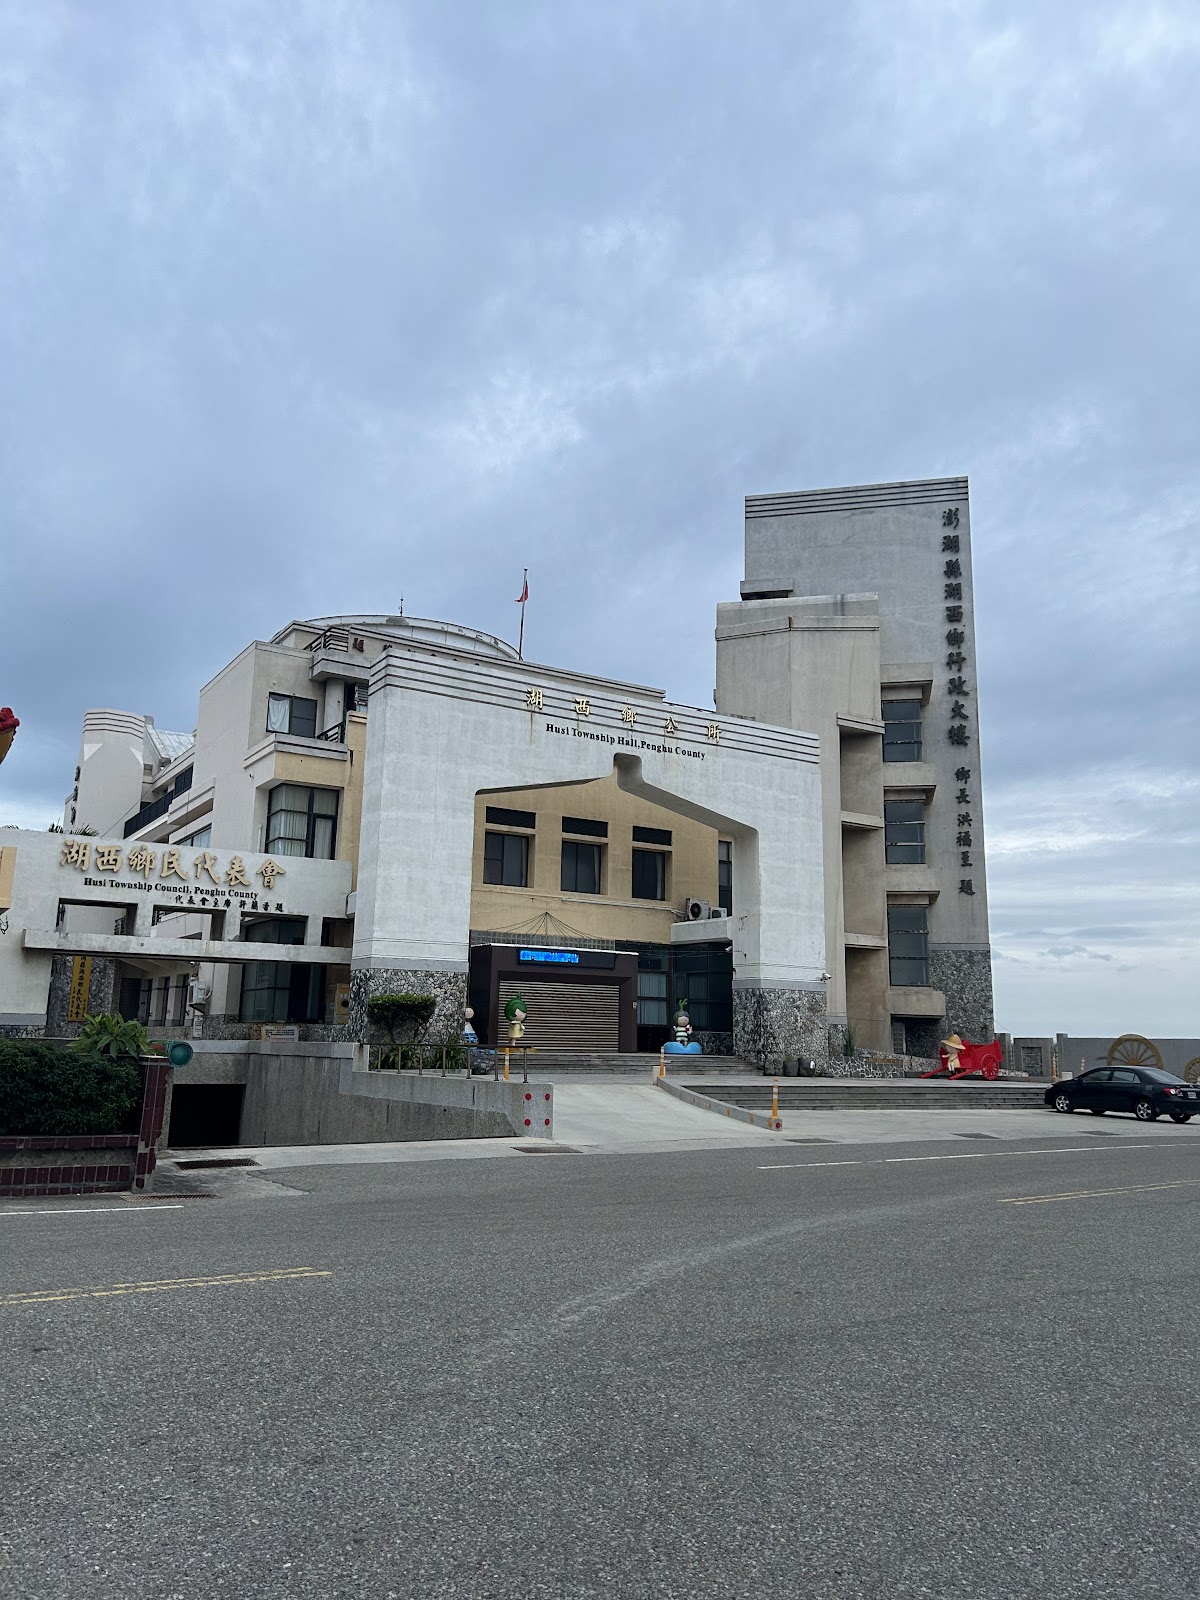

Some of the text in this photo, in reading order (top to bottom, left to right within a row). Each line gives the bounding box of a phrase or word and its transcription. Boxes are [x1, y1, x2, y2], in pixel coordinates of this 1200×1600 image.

[942, 507, 970, 746] 澎湖縣湖西鄉行政大樓
[526, 688, 721, 743] 湖西鄉公所
[546, 723, 569, 735] Husi
[572, 728, 615, 745] Township
[675, 746, 706, 760] County
[60, 839, 286, 890] 湖西鄉民代表會
[84, 877, 259, 900] Husi Township Council, Penghu County
